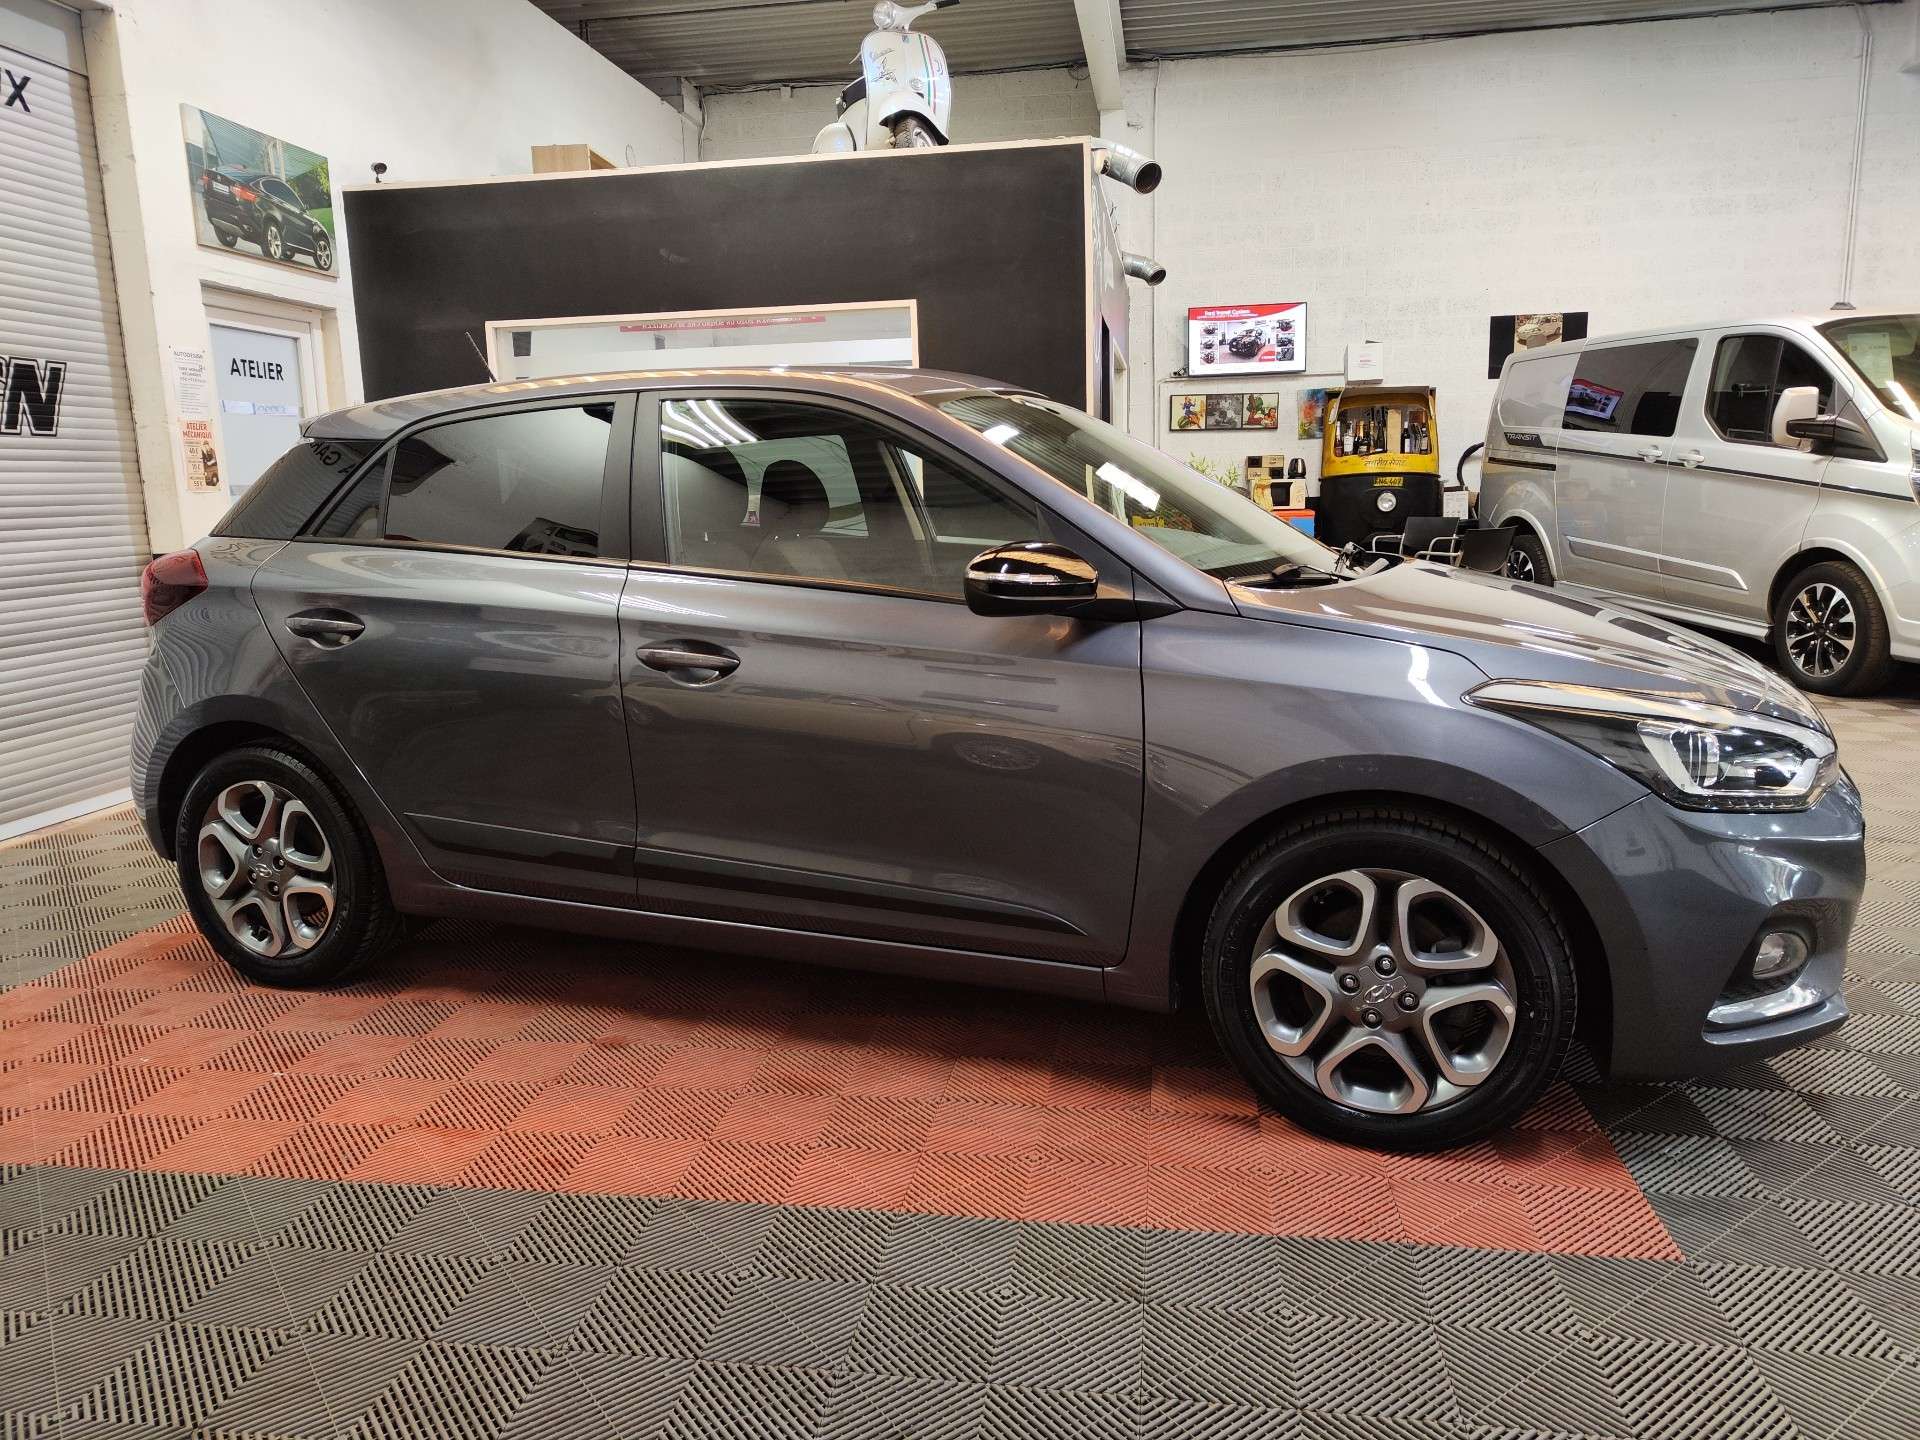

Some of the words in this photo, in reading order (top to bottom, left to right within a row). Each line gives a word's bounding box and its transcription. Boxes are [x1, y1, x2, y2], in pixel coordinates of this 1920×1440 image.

[0, 66, 32, 113] X
[230, 357, 284, 381] ATELIER
[0, 355, 67, 437] N
[186, 422, 208, 431] ATELIER
[1507, 433, 1537, 441] TRANSIT
